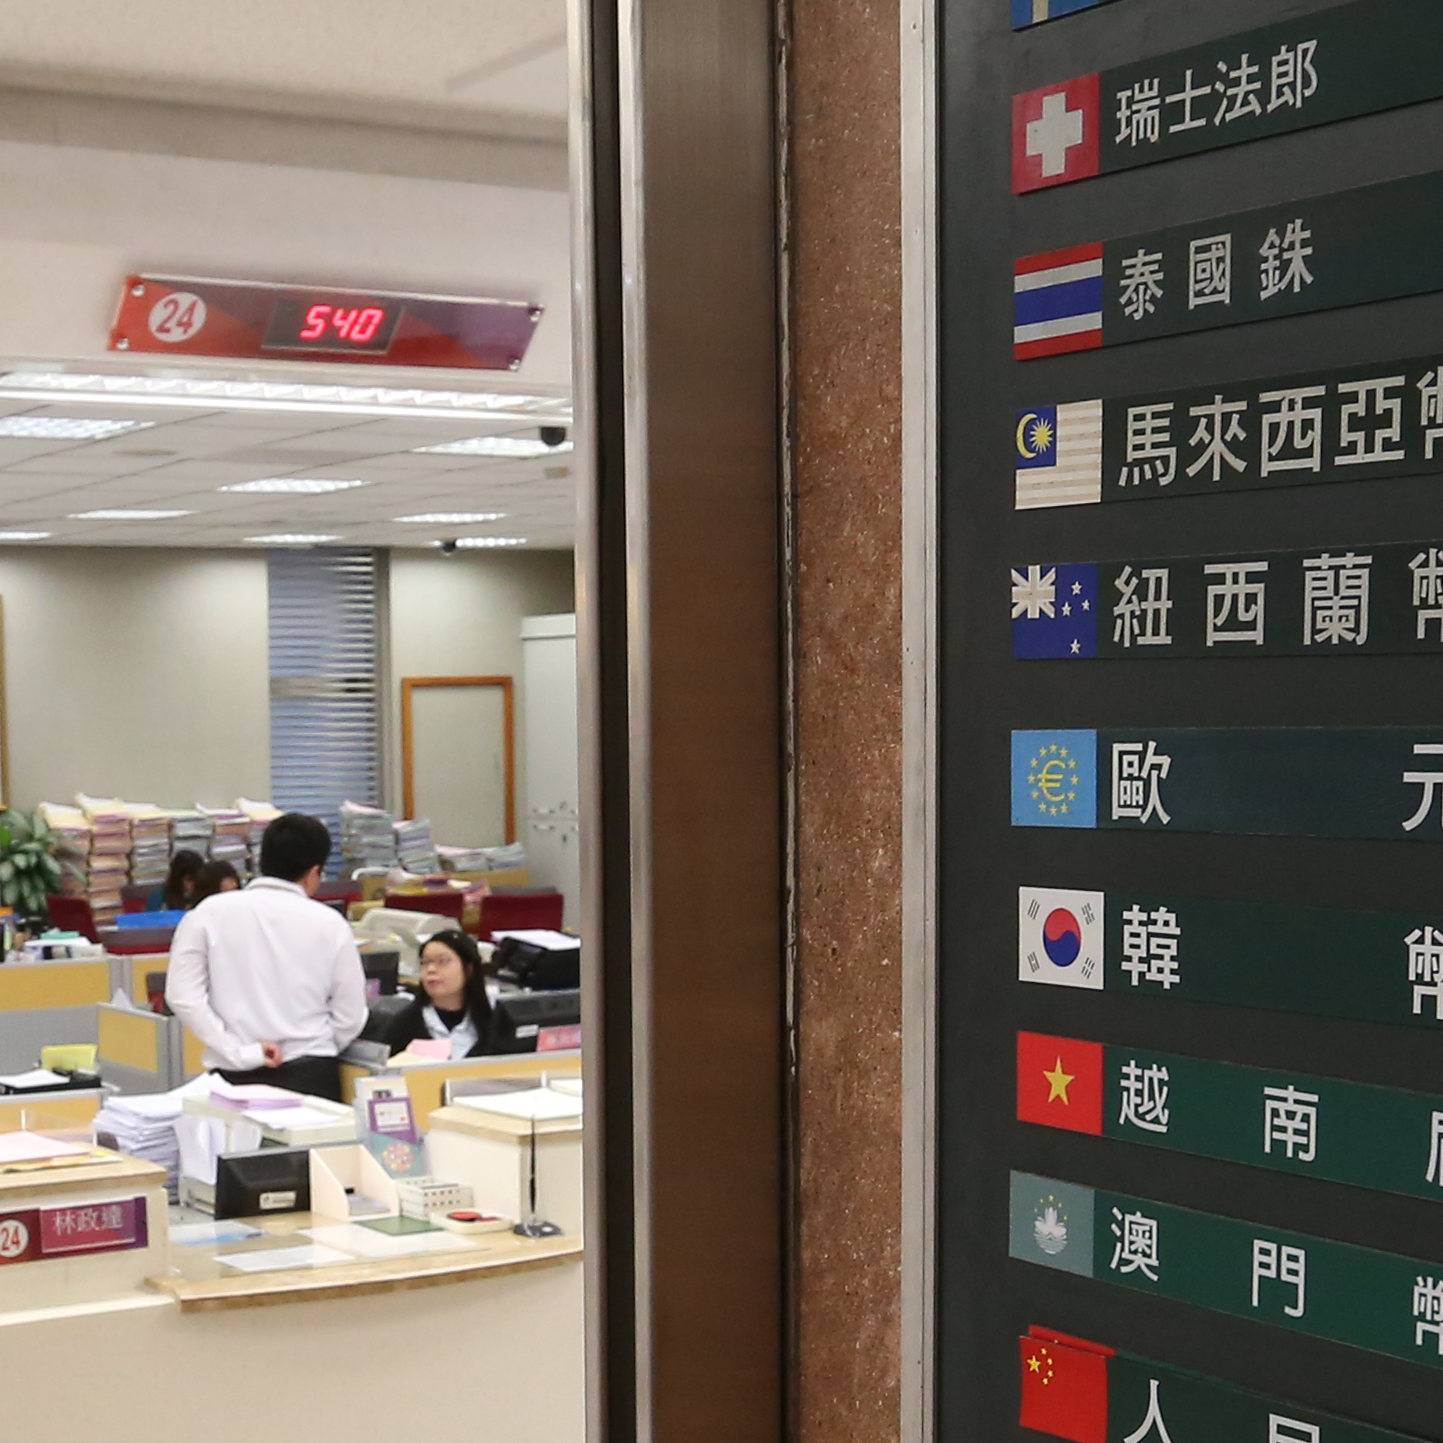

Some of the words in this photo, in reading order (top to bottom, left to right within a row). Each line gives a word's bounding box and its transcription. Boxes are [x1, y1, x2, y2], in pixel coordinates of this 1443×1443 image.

[1116, 40, 1317, 146] 瑞士法郎
[1119, 219, 1313, 320] 泰國銖
[156, 297, 195, 336] 24
[299, 304, 385, 342] 540
[0, 1227, 21, 1251] 24
